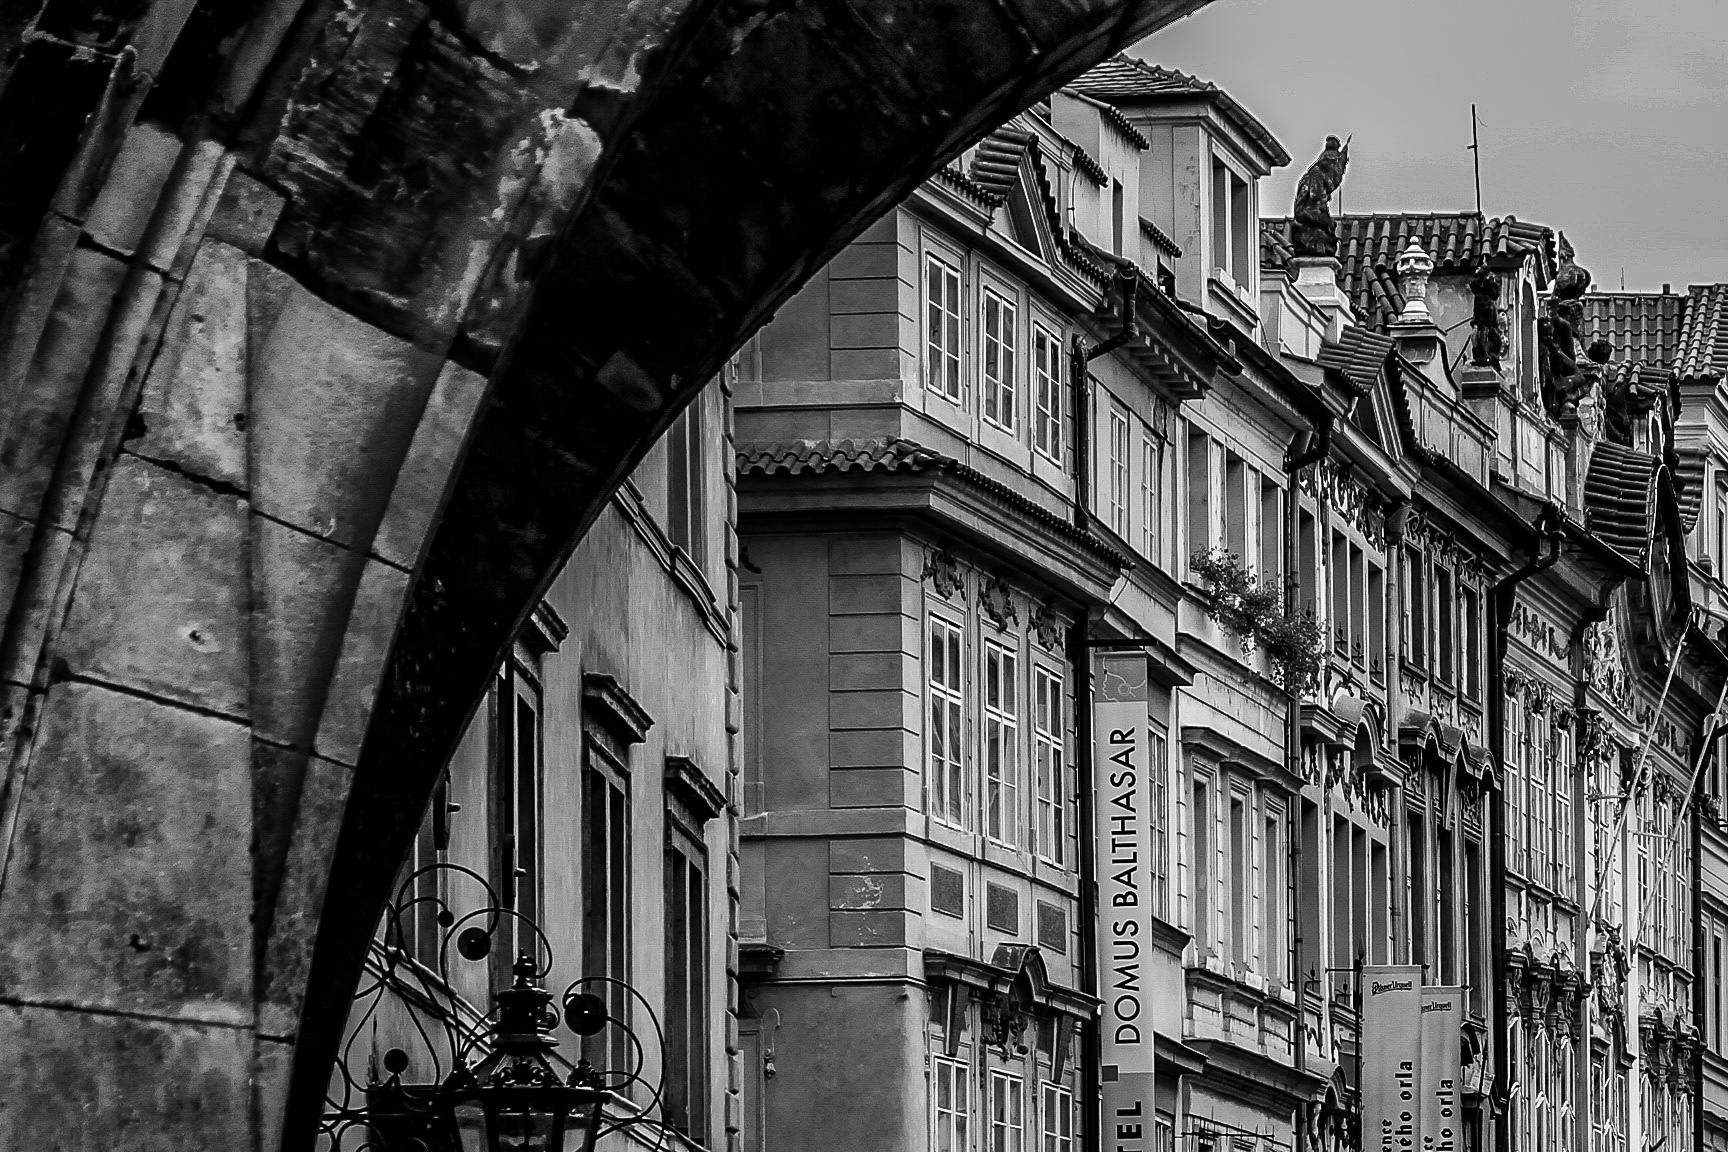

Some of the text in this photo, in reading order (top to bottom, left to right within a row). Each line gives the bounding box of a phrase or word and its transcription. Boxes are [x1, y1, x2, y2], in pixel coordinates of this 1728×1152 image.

[1111, 727, 1141, 1045] DOMUS BALTHASAR
[1394, 1061, 1412, 1101] orla
[1436, 1079, 1453, 1118] orla
